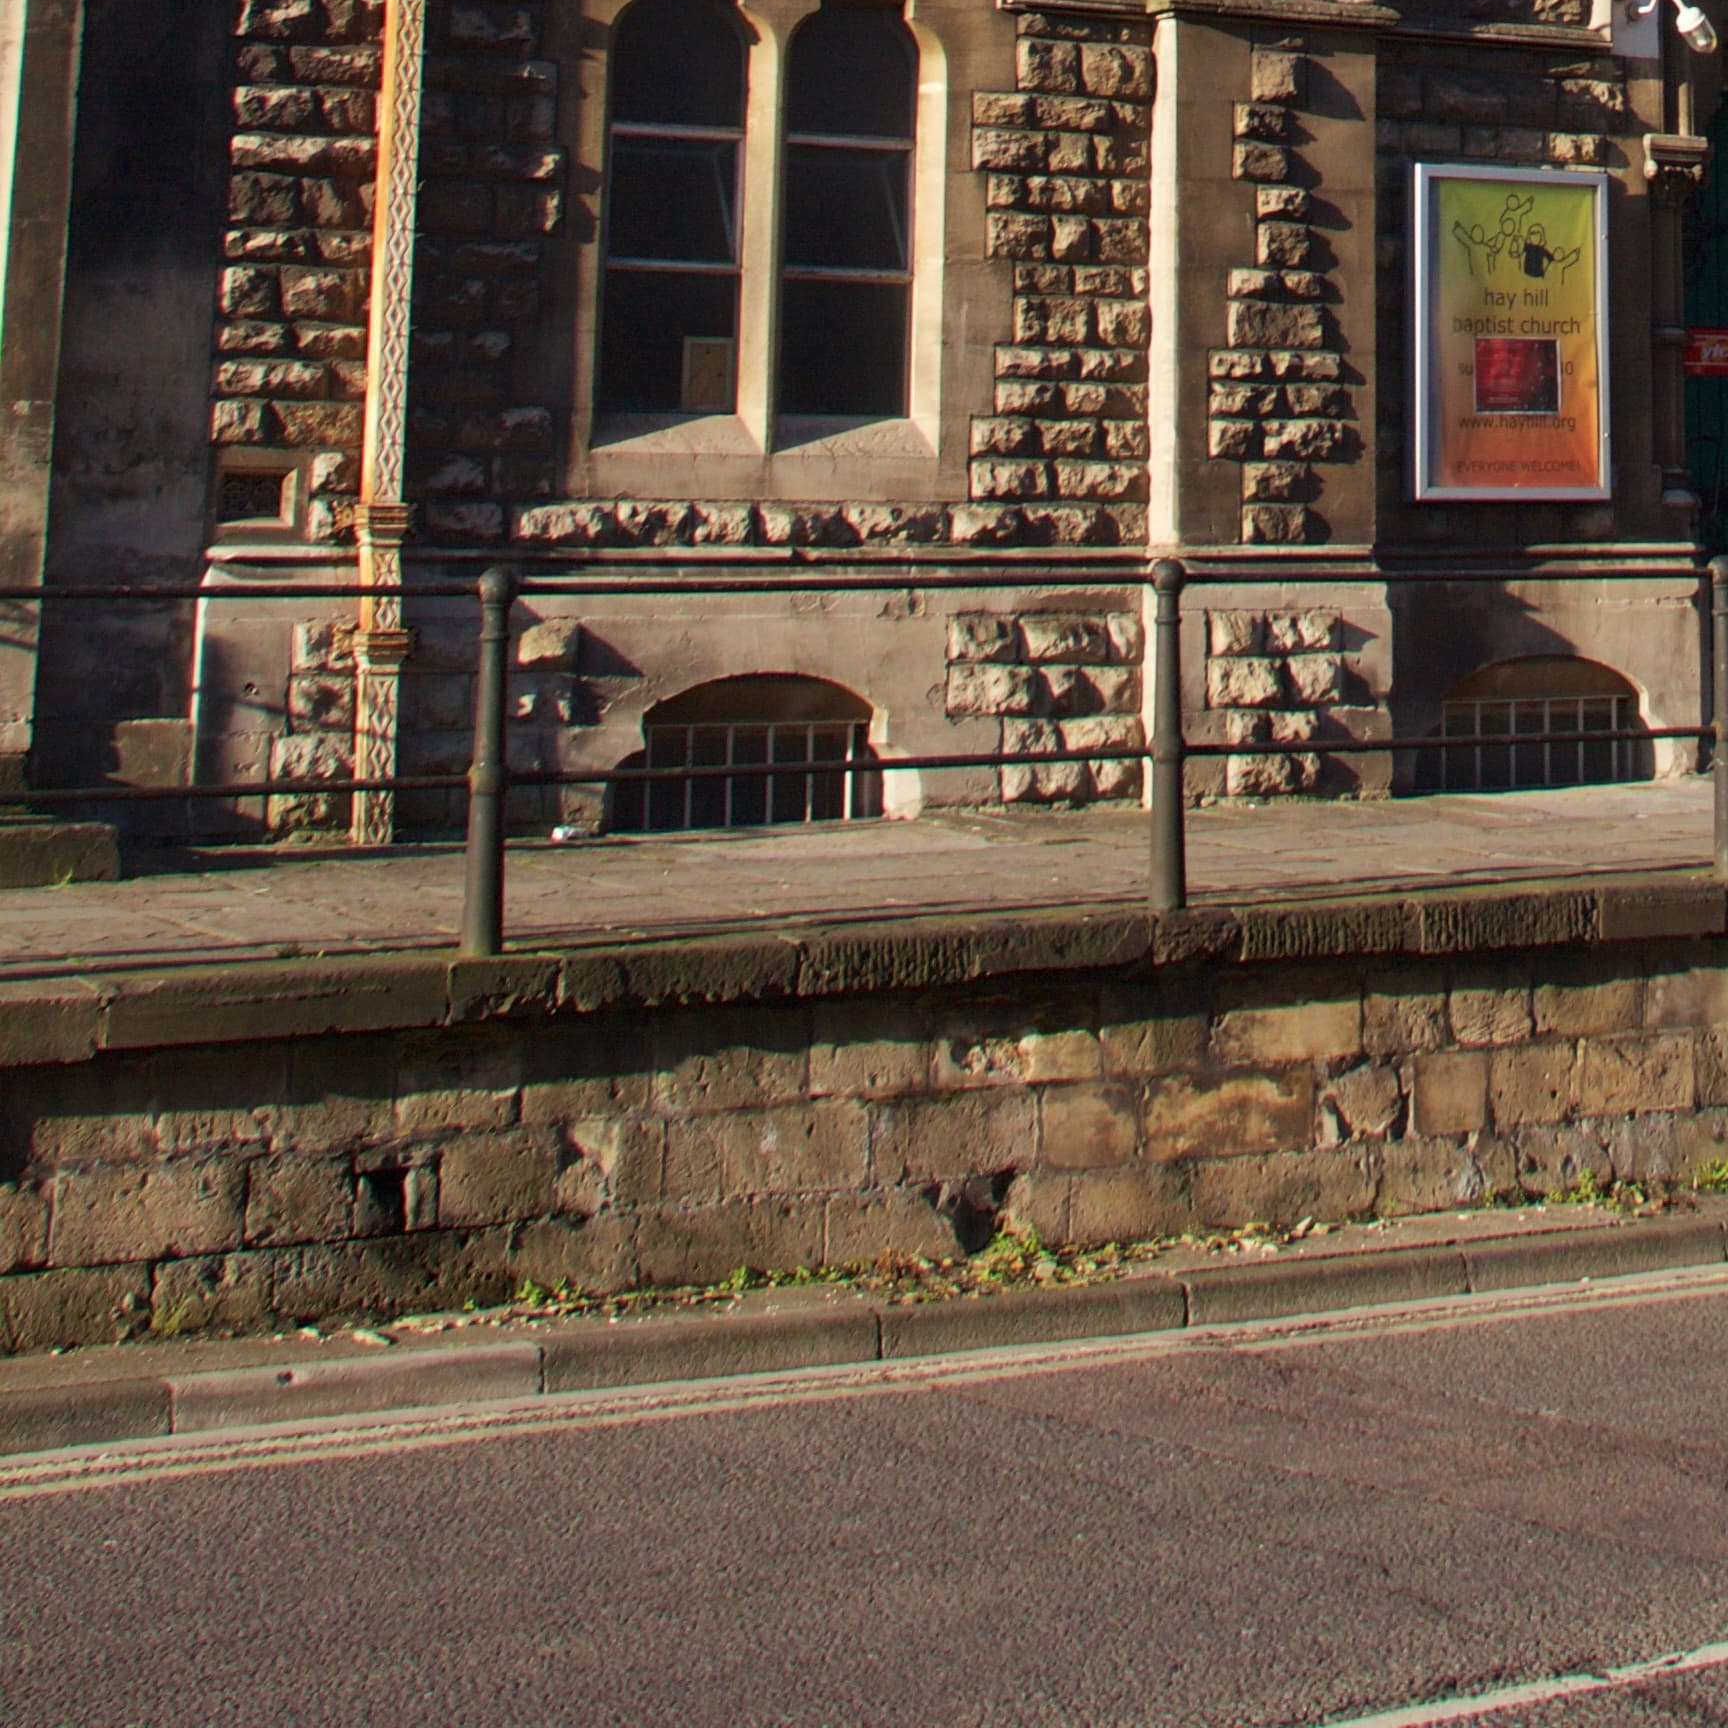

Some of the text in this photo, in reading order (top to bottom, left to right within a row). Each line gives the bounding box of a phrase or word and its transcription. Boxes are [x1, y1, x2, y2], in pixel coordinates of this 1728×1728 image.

[1484, 288, 1549, 308] hay hill
[1453, 317, 1581, 336] baptist church
[1456, 461, 1516, 474] EVERYONE
